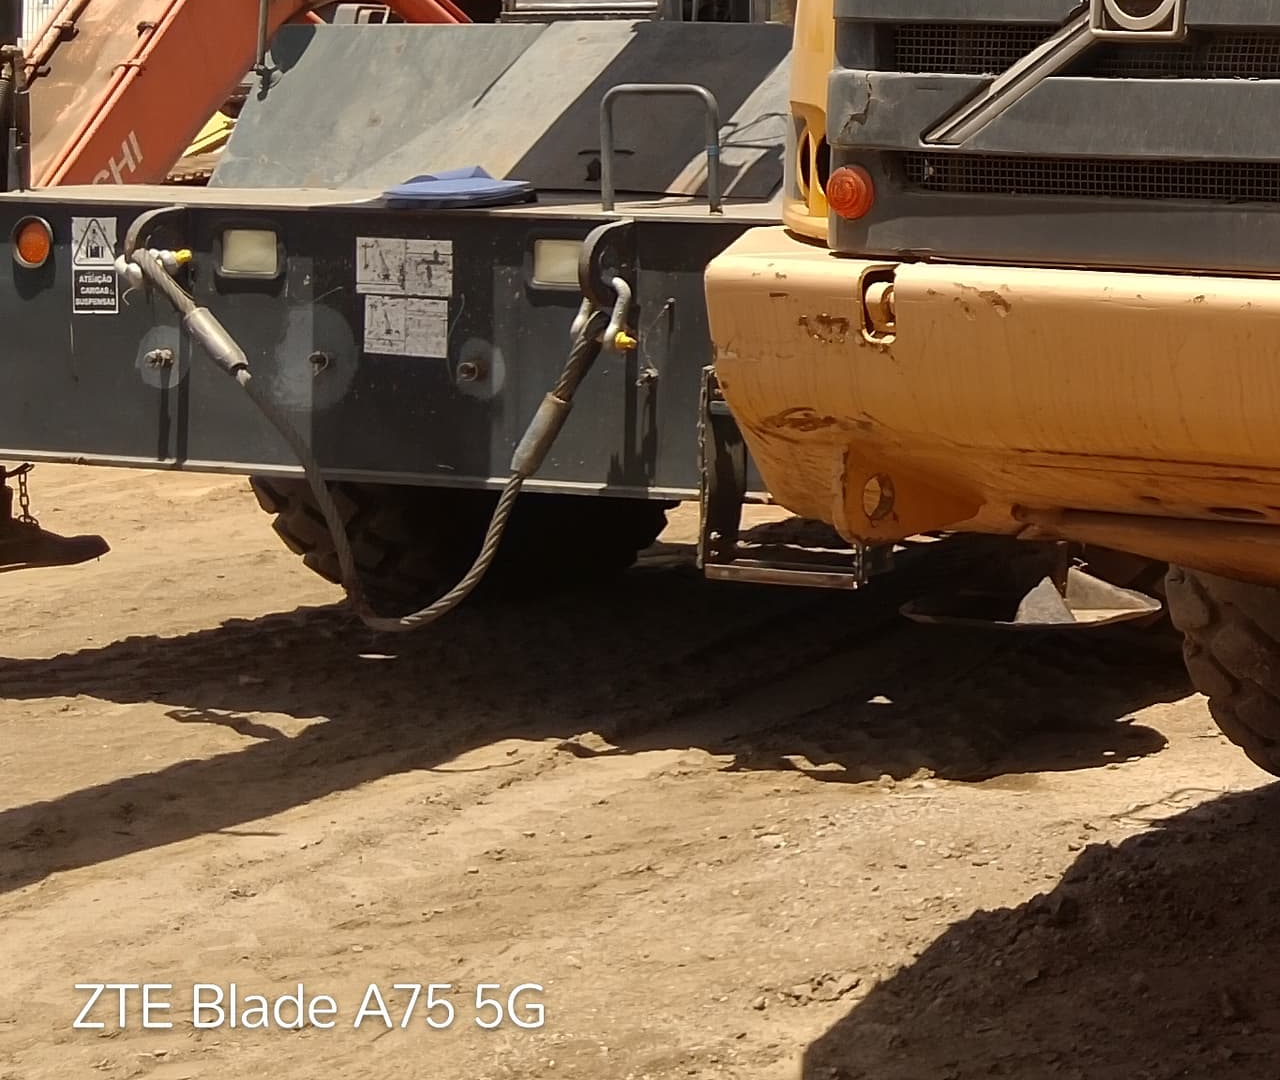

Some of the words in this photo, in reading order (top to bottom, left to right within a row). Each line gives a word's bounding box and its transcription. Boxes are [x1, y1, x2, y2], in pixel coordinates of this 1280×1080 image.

[79, 273, 113, 284] ATENÇÃO
[80, 286, 110, 295] CARGAS
[76, 297, 115, 306] SUSPENSAS
